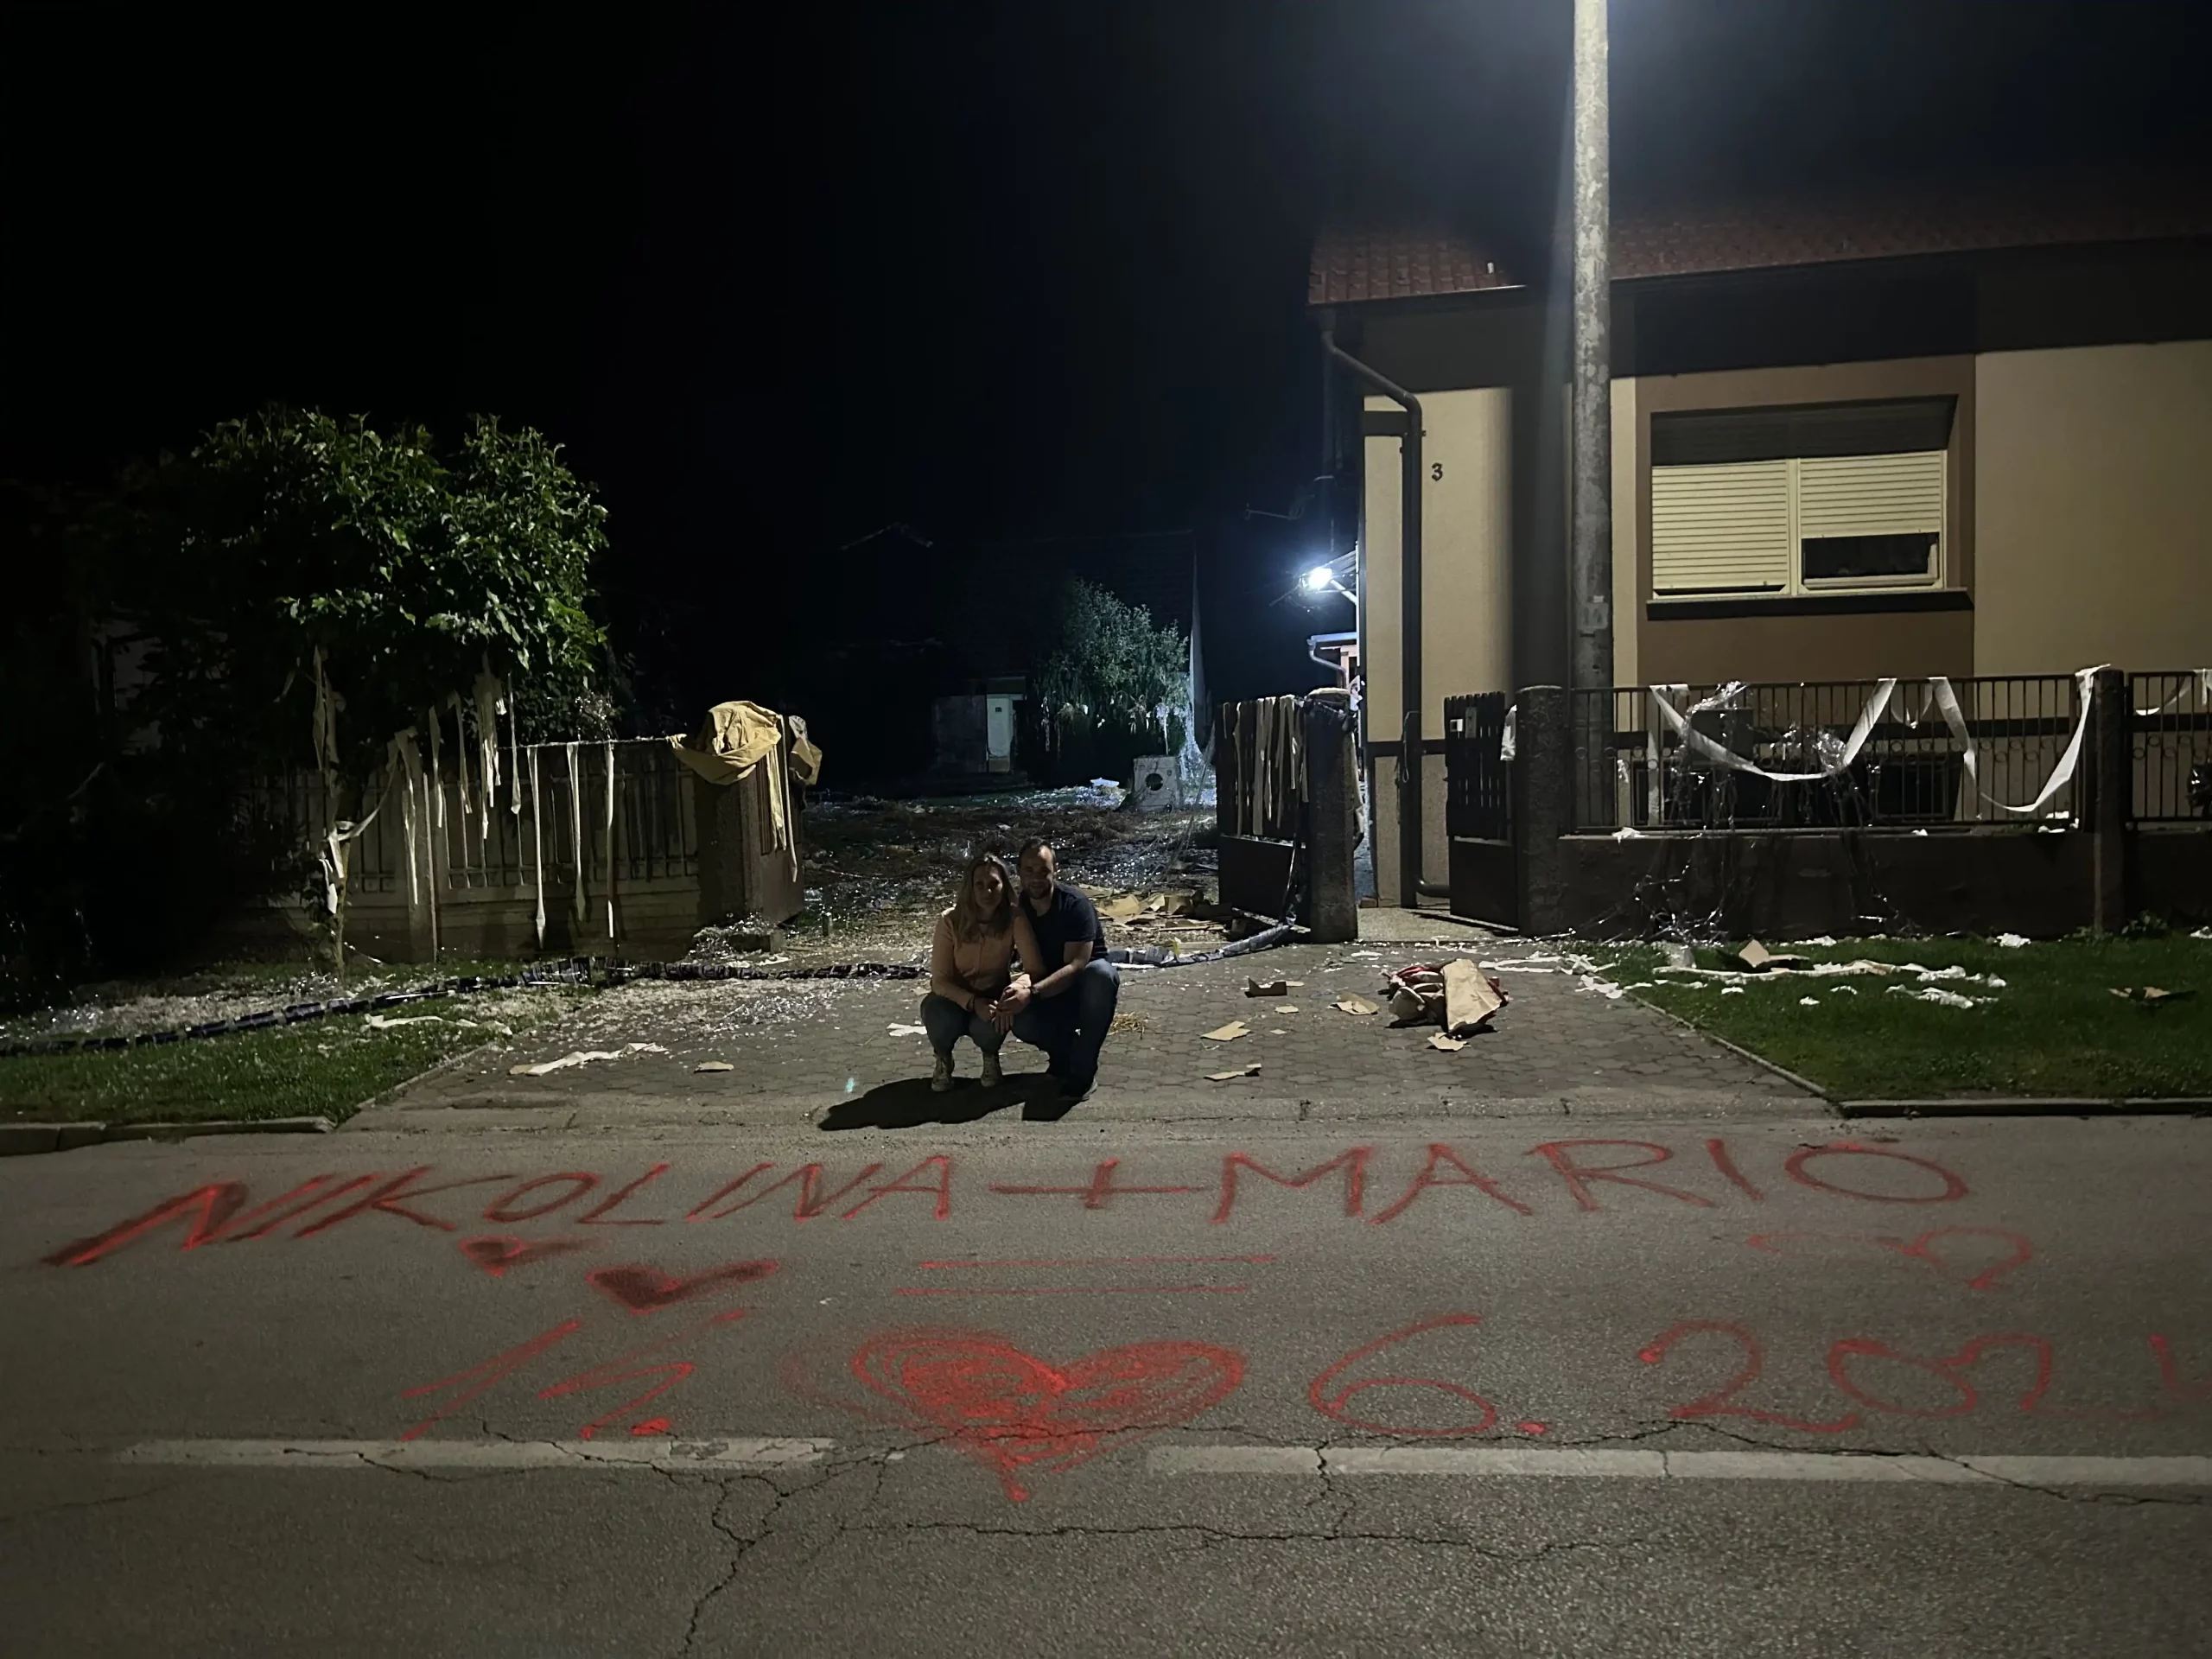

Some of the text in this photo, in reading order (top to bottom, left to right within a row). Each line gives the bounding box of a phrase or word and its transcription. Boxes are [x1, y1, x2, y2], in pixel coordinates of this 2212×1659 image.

[1431, 461, 1444, 482] 3
[41, 1153, 952, 1268] NIKOLINA
[1211, 1139, 1971, 1225] MARIO
